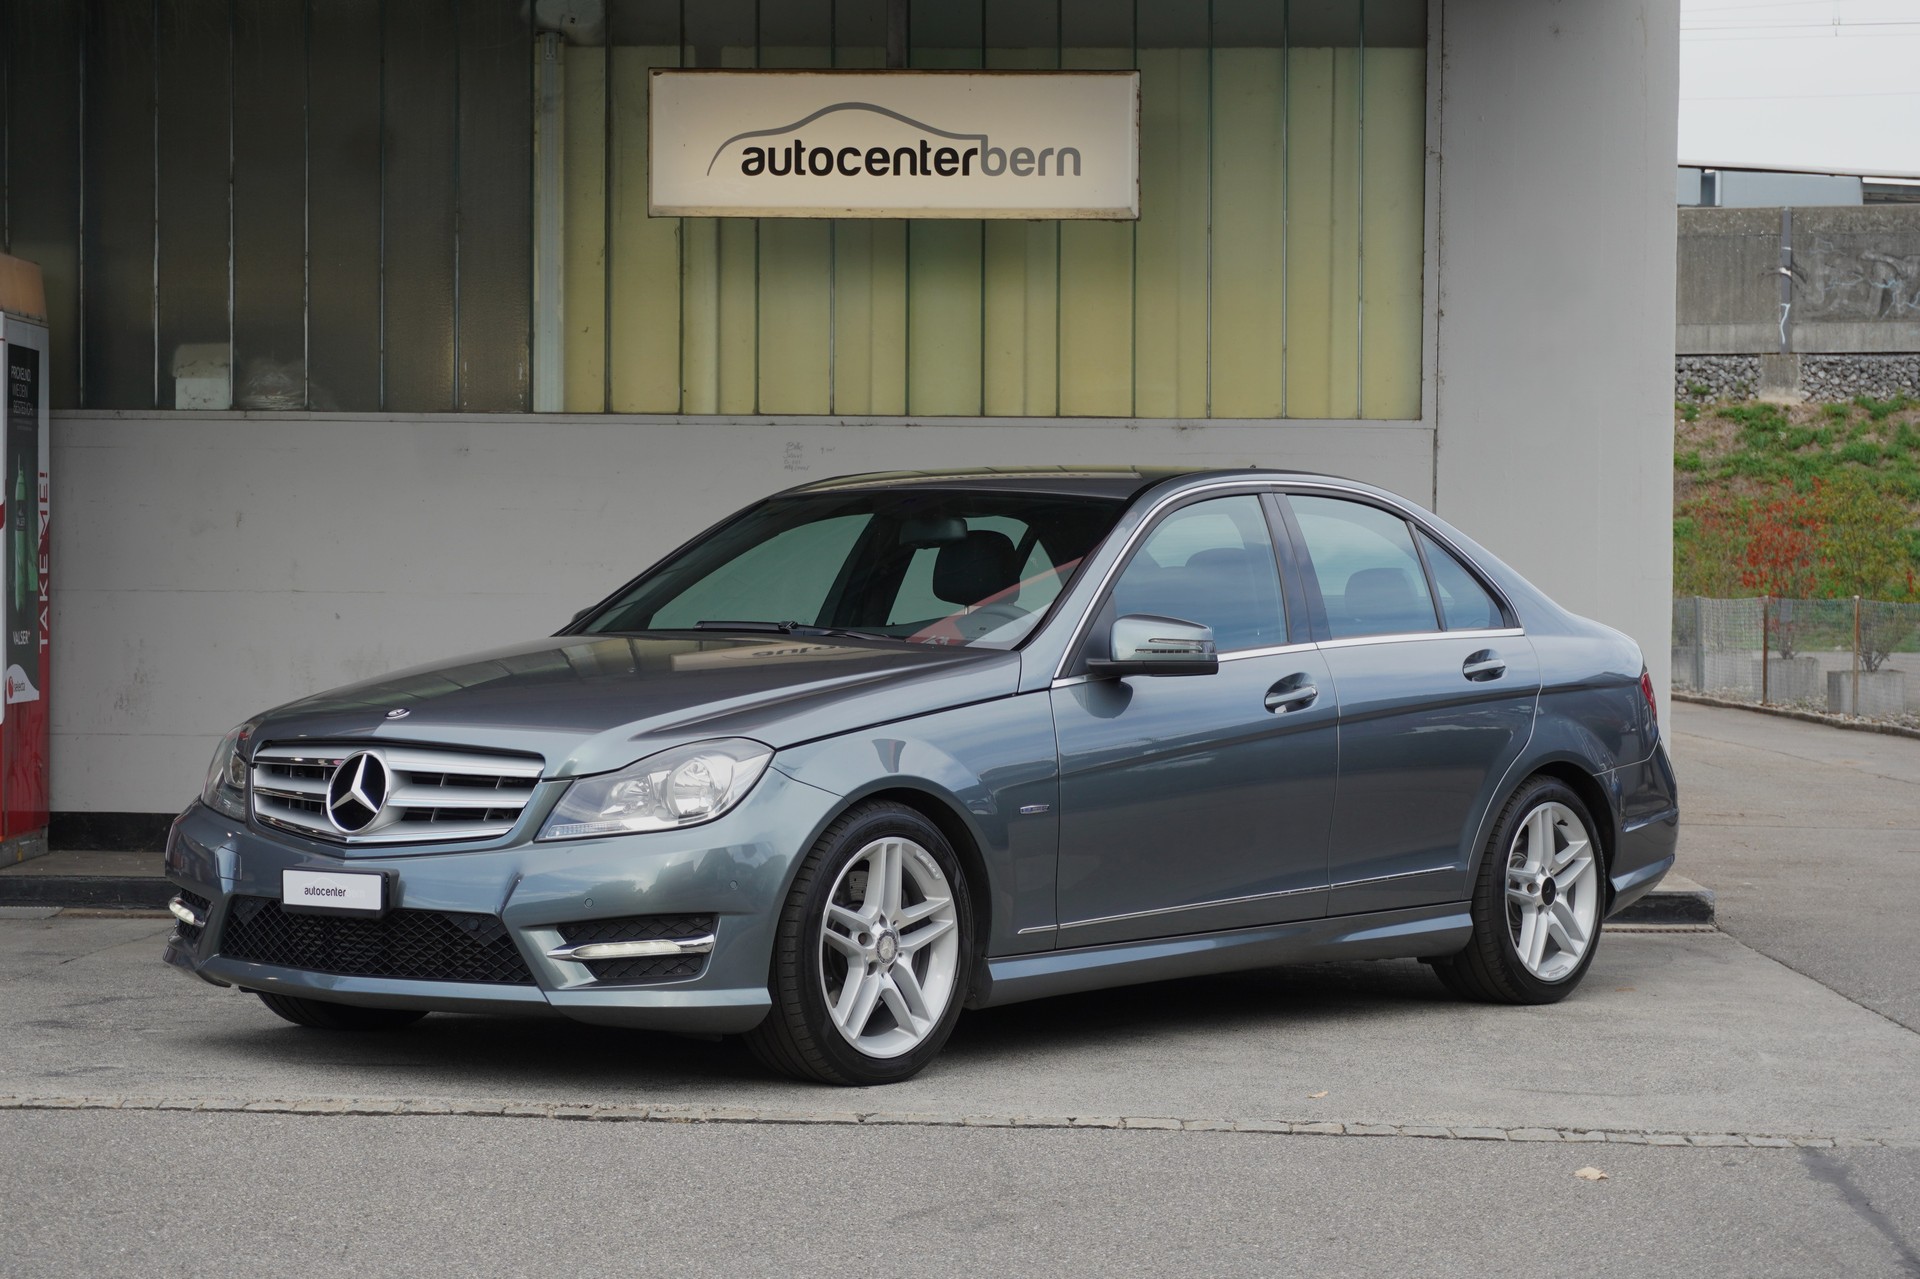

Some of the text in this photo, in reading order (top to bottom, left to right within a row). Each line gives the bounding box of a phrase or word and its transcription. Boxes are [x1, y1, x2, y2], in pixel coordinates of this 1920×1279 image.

[40, 472, 48, 653] TAKE ME!
[304, 886, 346, 897] autocenter
